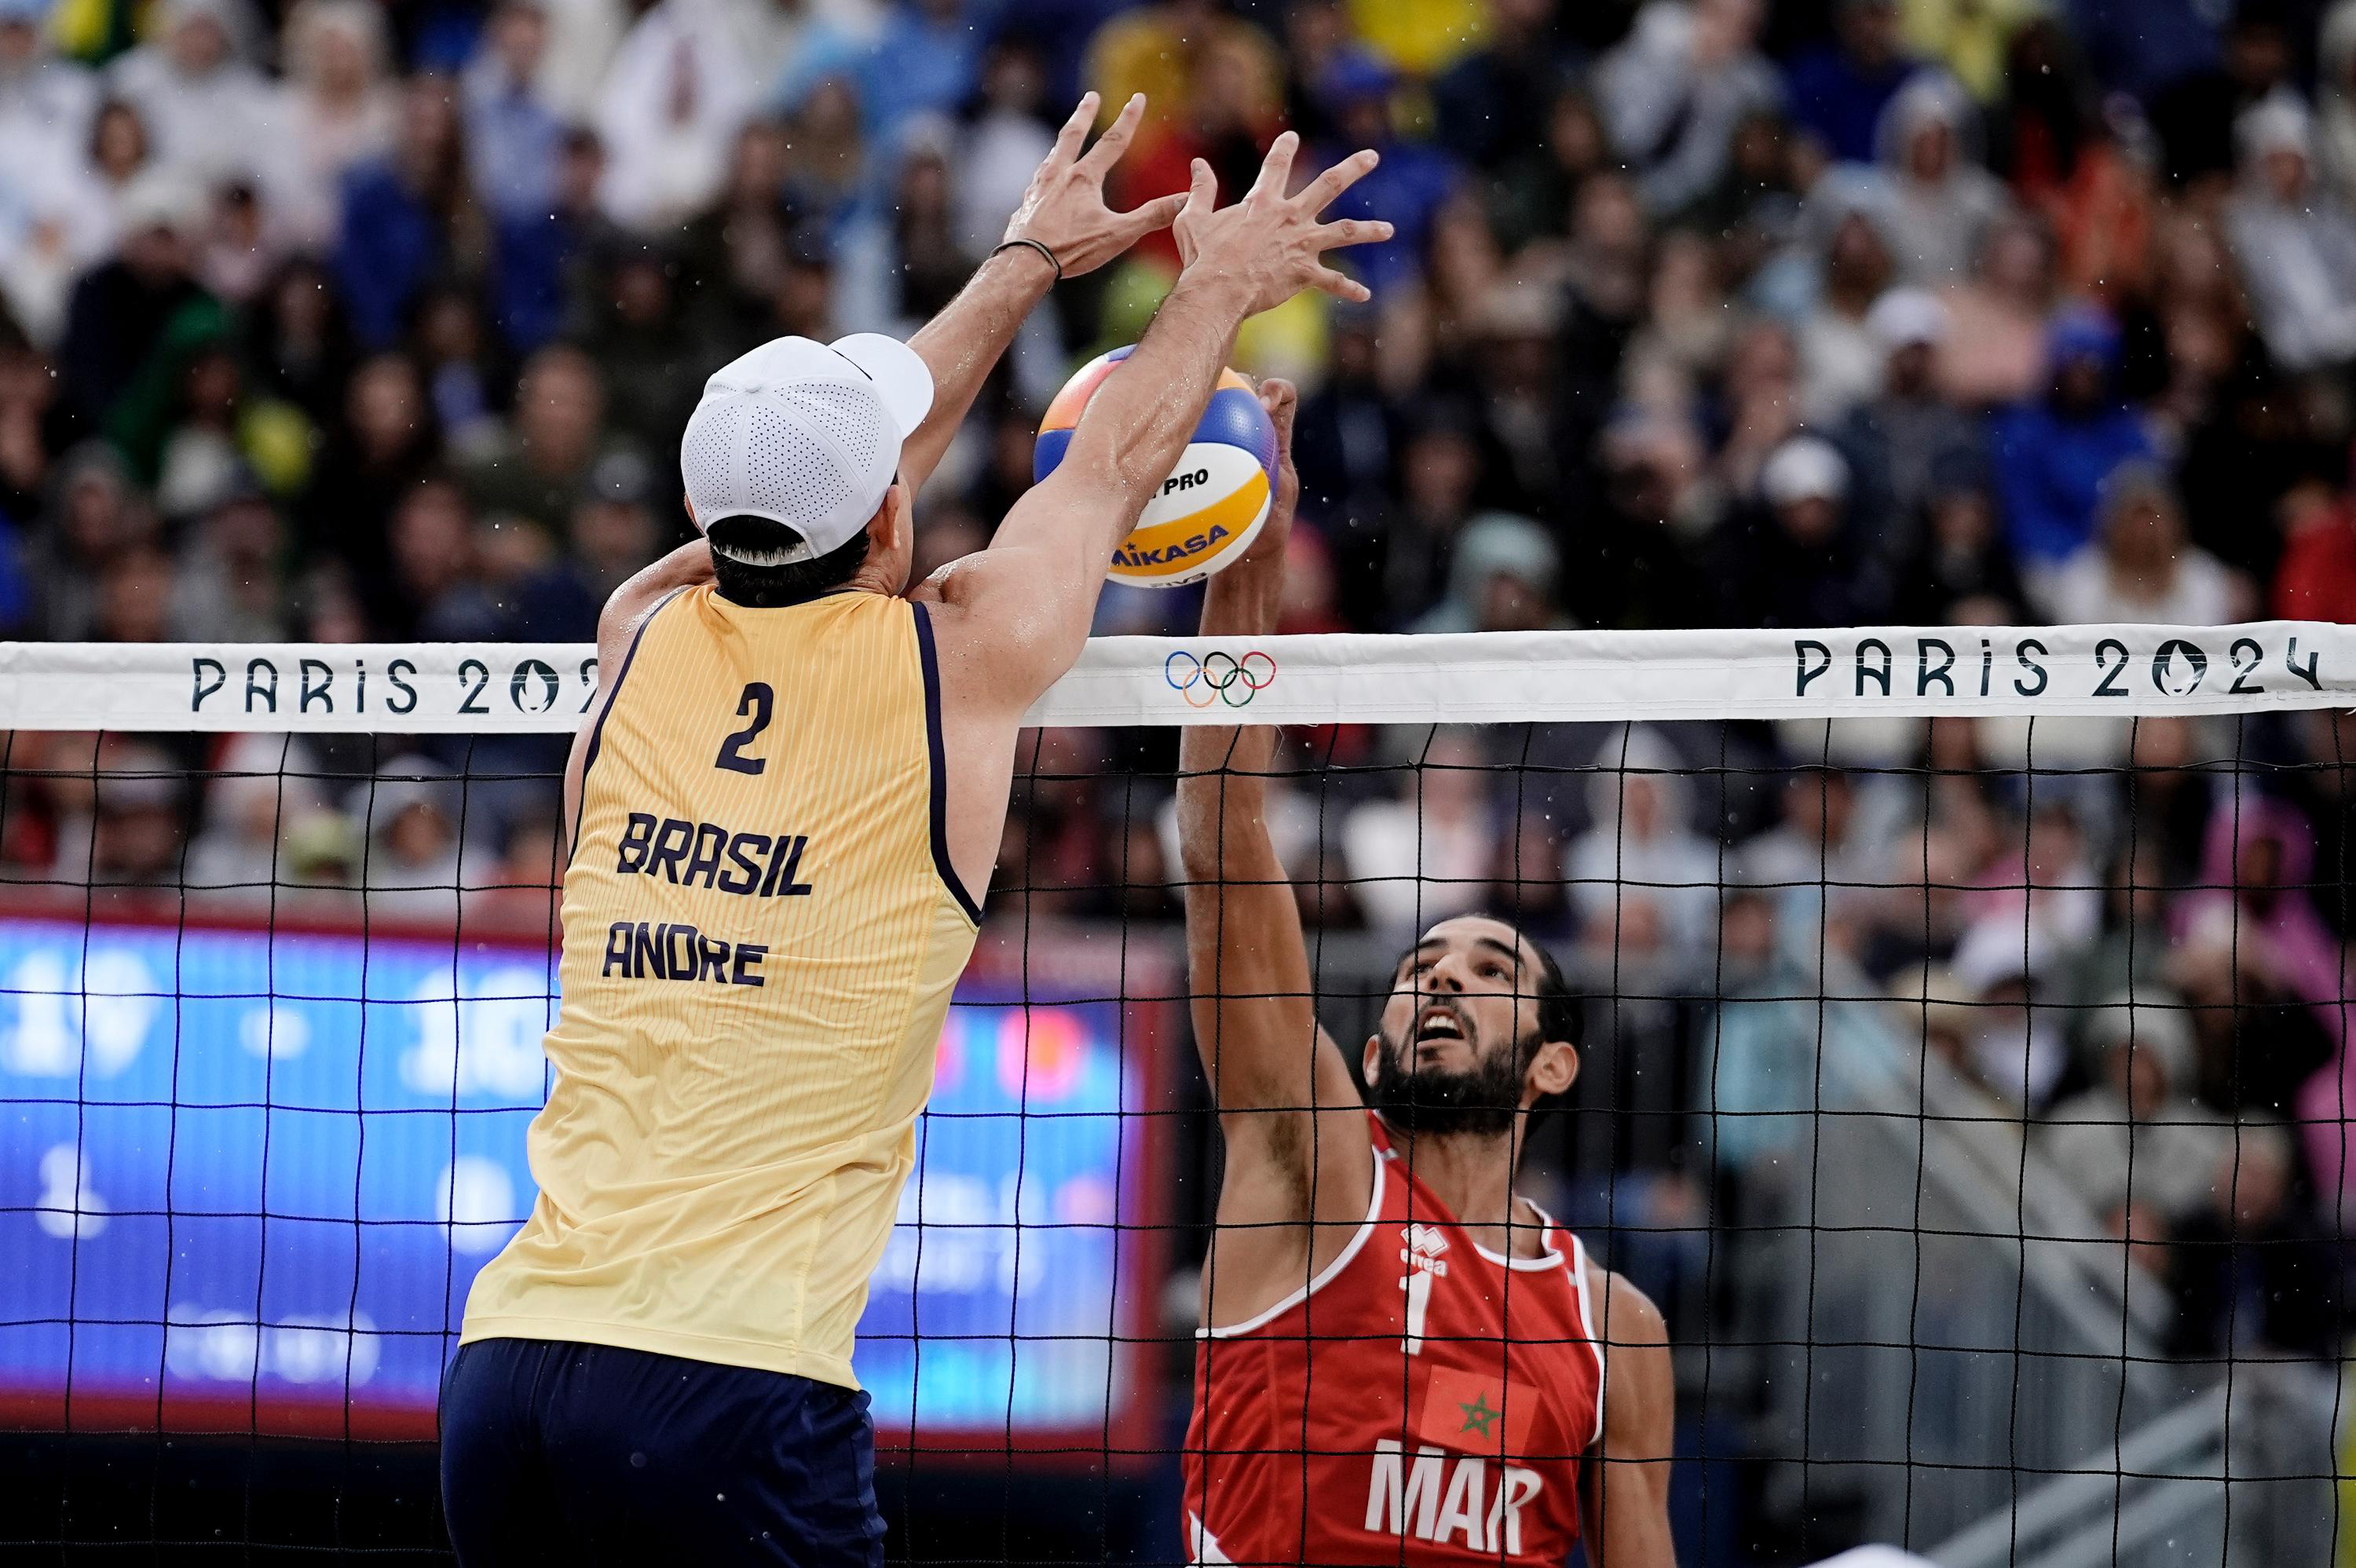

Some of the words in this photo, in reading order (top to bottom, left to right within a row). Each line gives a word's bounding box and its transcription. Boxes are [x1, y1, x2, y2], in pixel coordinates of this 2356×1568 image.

[1163, 468, 1209, 496] PRO
[2091, 637, 2324, 696] 2024
[715, 682, 774, 776] 2
[616, 812, 813, 898] BRASIL
[602, 921, 769, 987] ANDRE
[1399, 1270, 1433, 1357] 1
[1364, 1438, 1542, 1556] MAR
